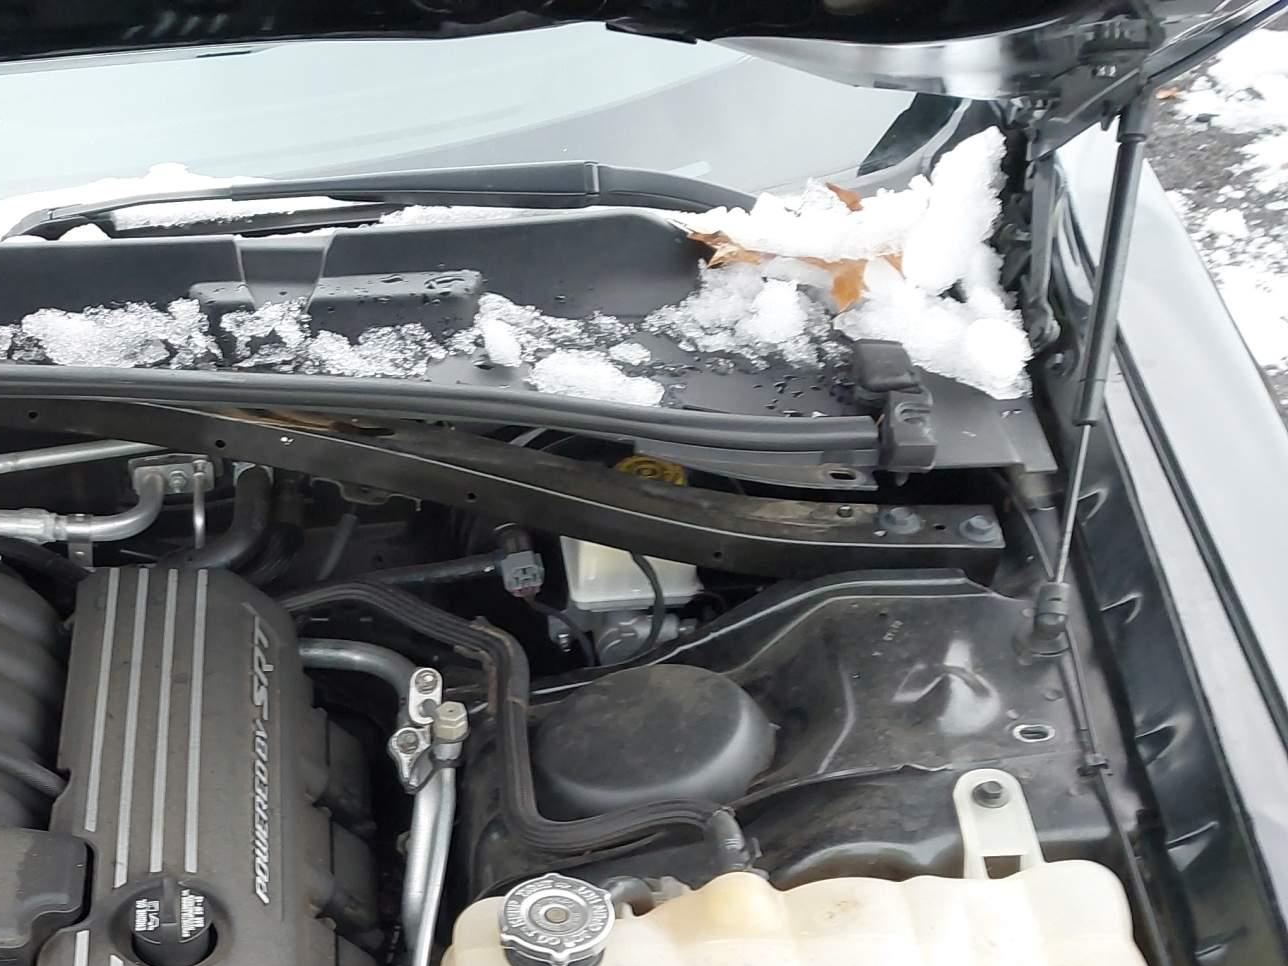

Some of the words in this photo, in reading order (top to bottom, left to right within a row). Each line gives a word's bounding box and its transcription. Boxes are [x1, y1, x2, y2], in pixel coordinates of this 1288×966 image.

[253, 615, 275, 721] SRT
[254, 719, 269, 762] BY
[254, 759, 270, 904] POWERED
